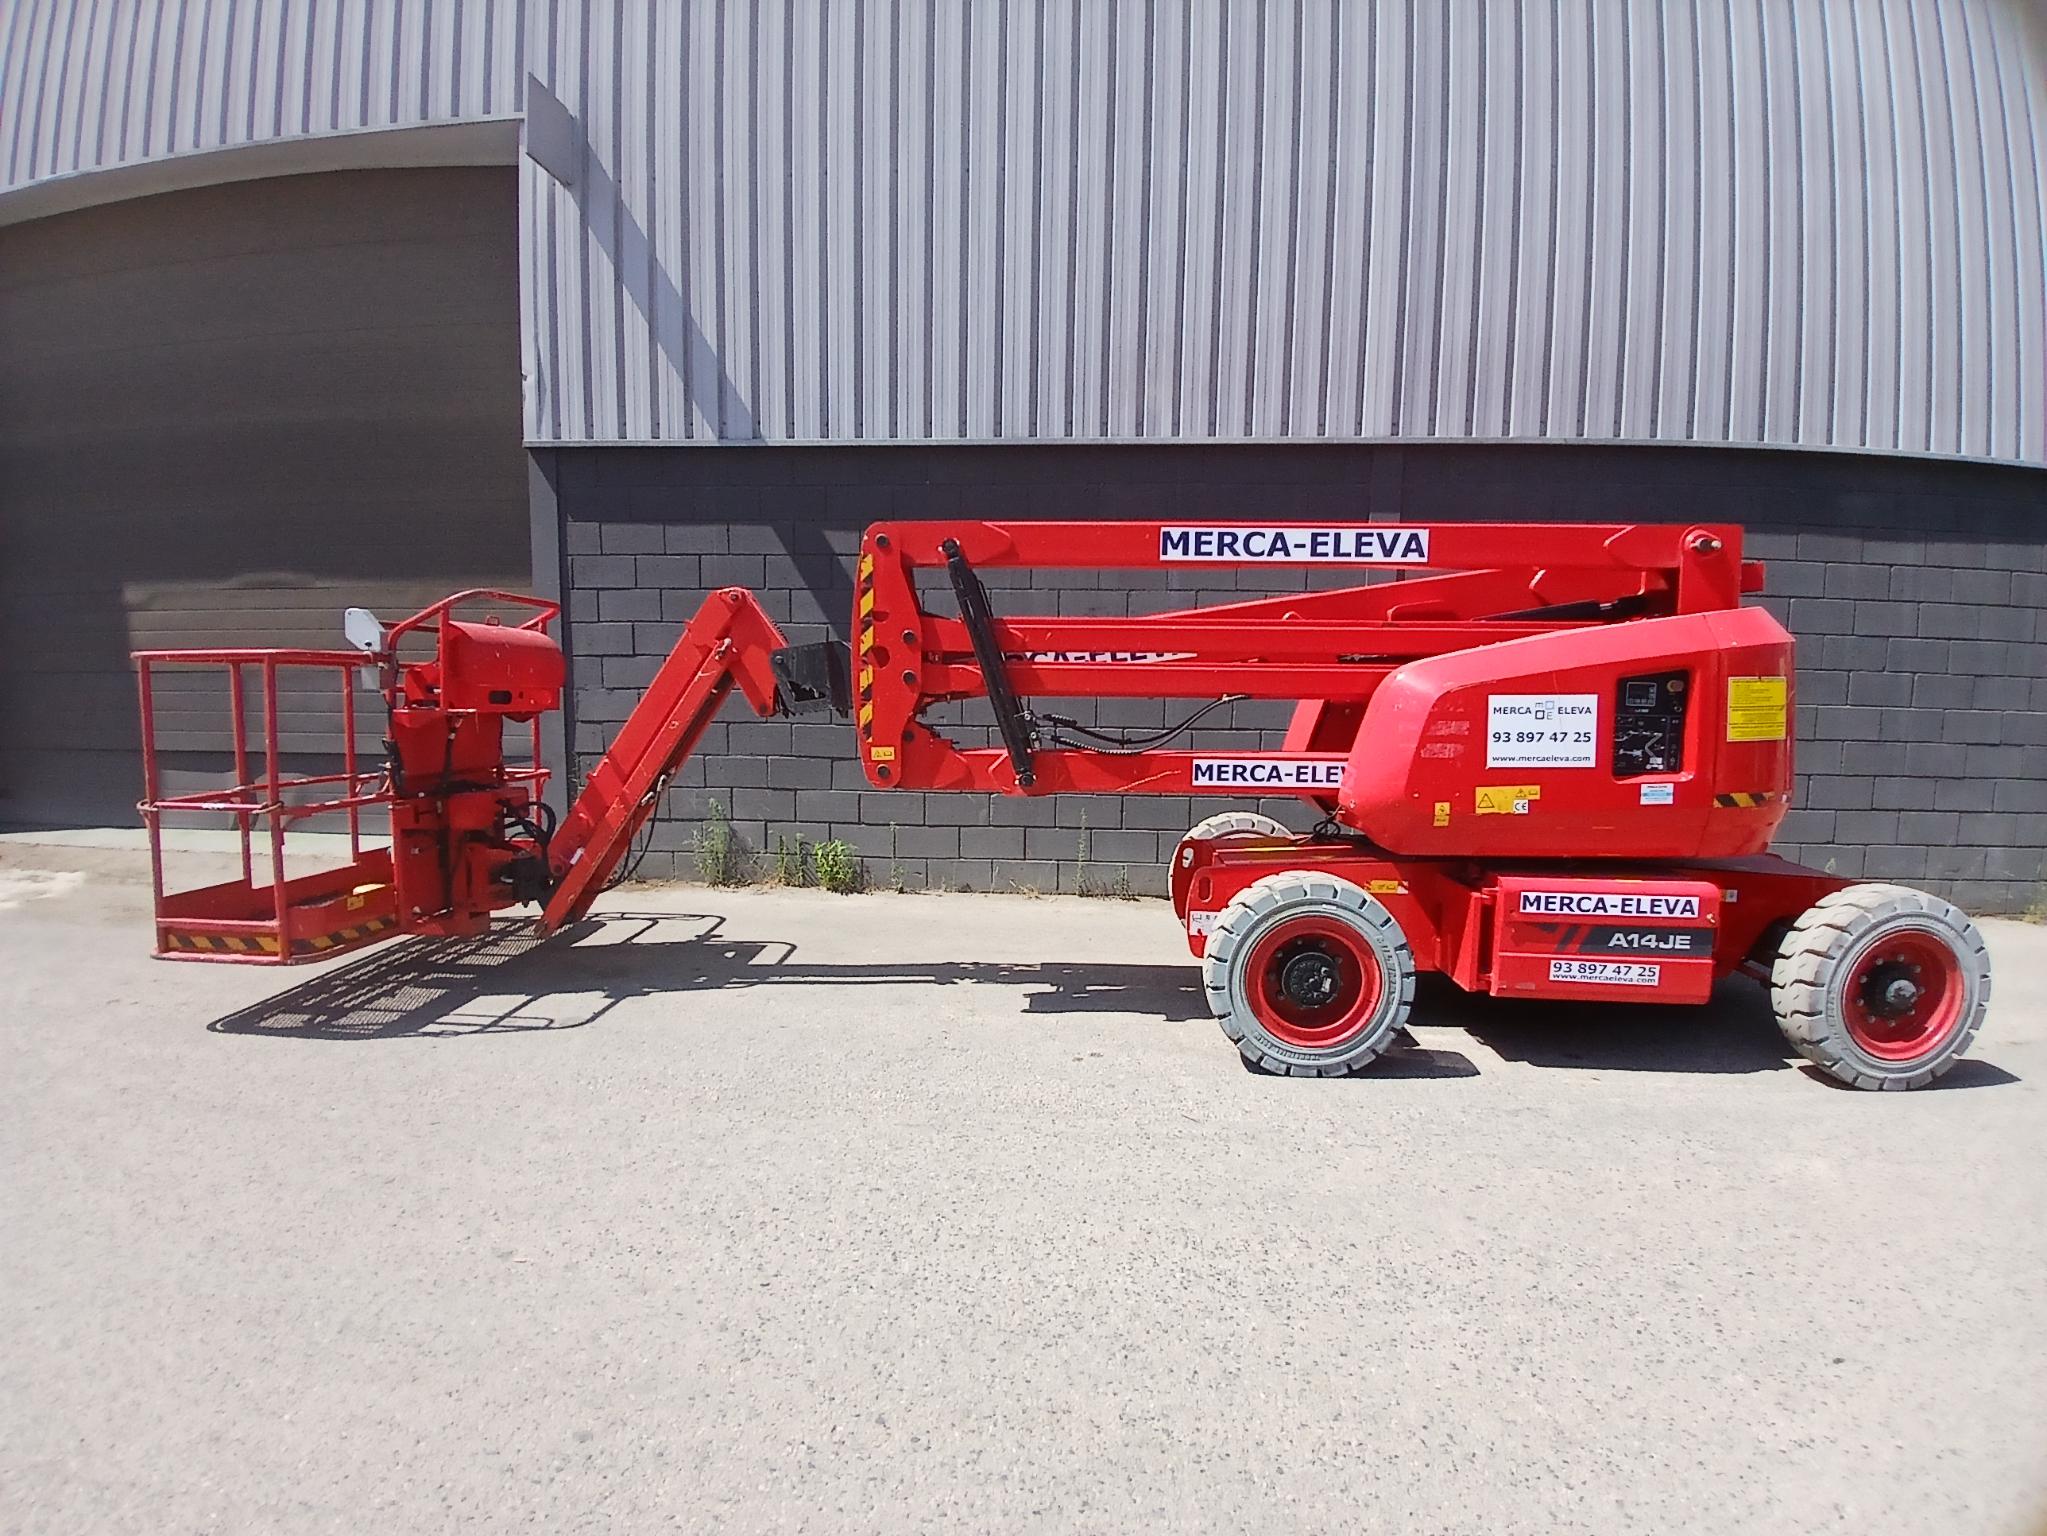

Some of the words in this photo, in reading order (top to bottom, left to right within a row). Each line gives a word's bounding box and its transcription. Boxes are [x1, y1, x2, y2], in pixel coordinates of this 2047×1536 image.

[1161, 530, 1426, 558] MERCA-ELEVA
[1493, 706, 1532, 715] MERCA
[1557, 706, 1592, 715] ELEVA
[1492, 731, 1511, 743] 93
[1516, 731, 1545, 743] 897
[1549, 731, 1568, 743] 47
[1573, 731, 1592, 743] 25
[1492, 754, 1591, 762] www.mercaeleva.com
[1193, 763, 1346, 783] MERCA-ELE
[1521, 894, 1696, 915] MERCA-ELEVA
[1607, 932, 1692, 949] A14JE
[1553, 962, 1573, 973] 93
[1577, 963, 1608, 975] 897
[1612, 965, 1632, 976] 47
[1637, 966, 1657, 977] 25
